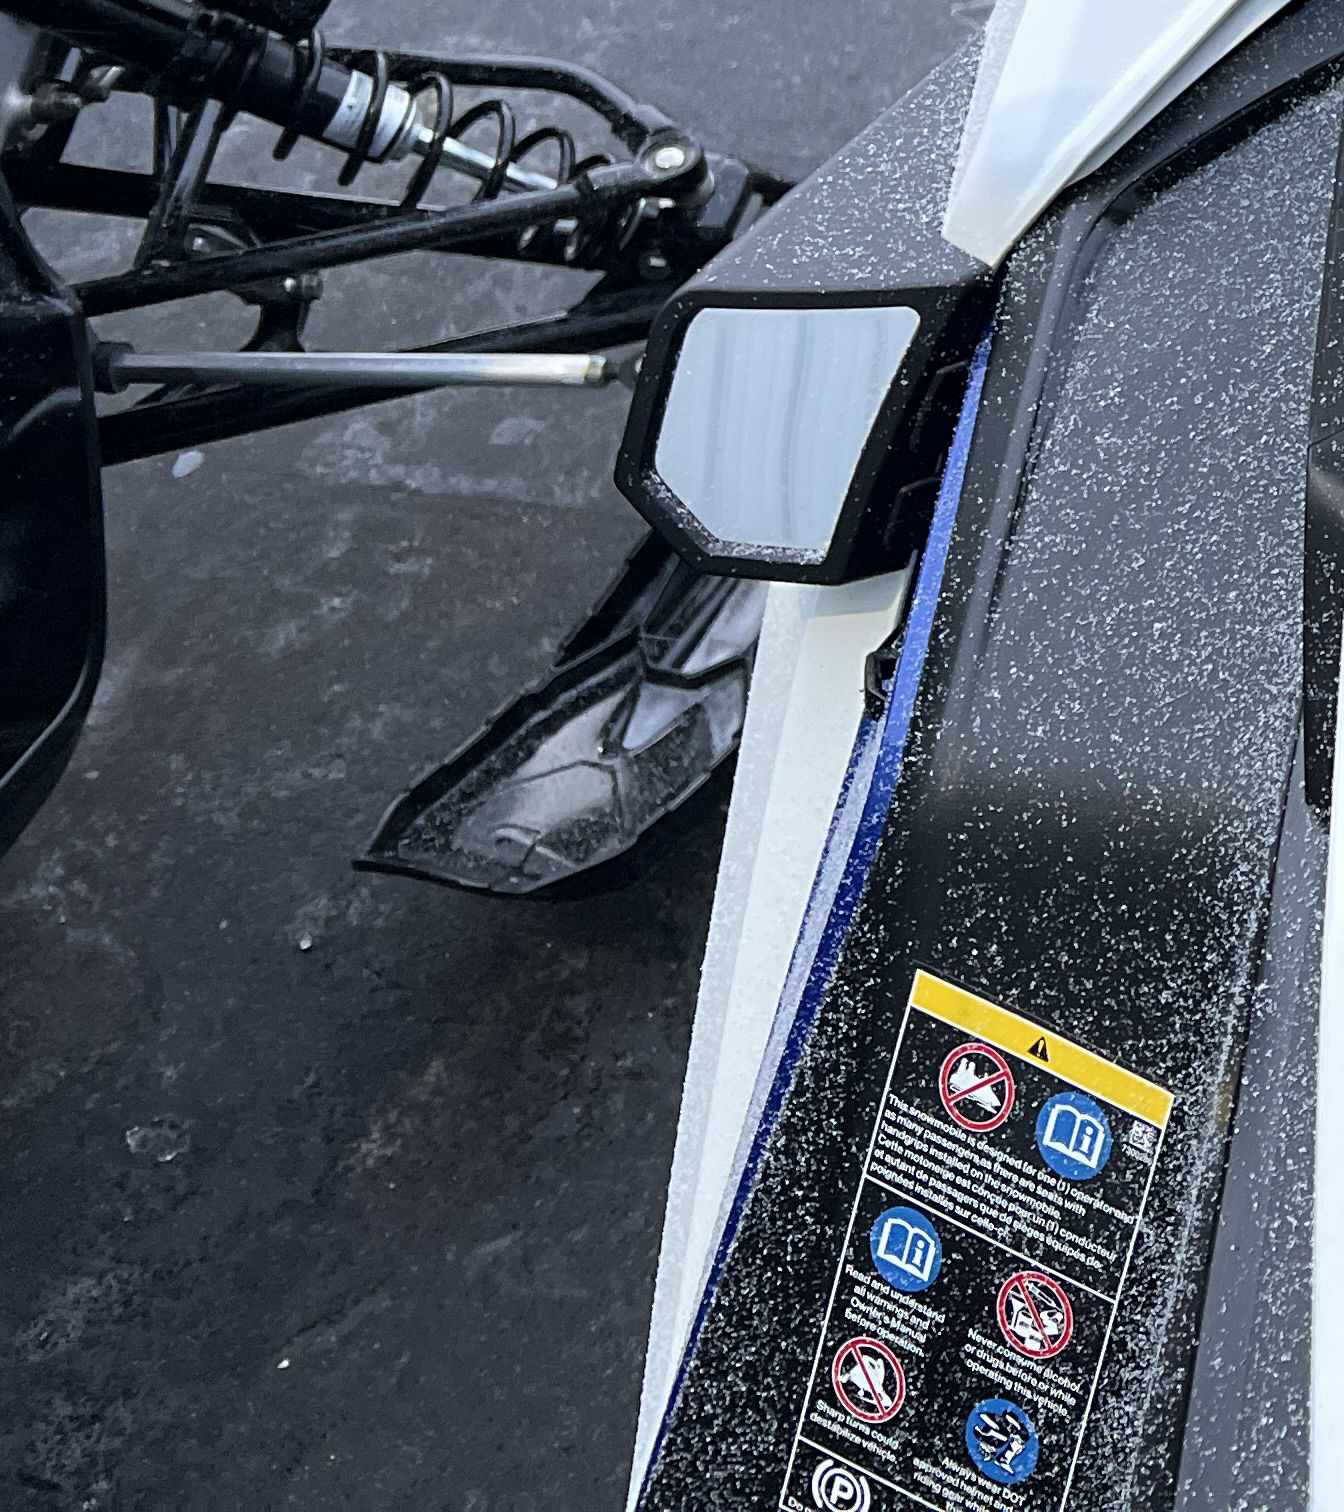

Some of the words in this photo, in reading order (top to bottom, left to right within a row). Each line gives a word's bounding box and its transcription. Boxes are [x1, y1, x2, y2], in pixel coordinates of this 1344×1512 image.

[880, 1120, 929, 1152] handgrips
[929, 1145, 970, 1174] installed
[970, 1168, 983, 1180] on
[984, 1173, 1000, 1189] the
[1000, 1183, 1062, 1220] snowmobile.
[884, 1109, 896, 1121] as
[896, 1115, 924, 1136] many
[923, 1129, 980, 1165] passengers
[978, 1158, 992, 1170] as
[993, 1161, 1019, 1183] there
[1018, 1177, 1036, 1192] are
[1036, 1184, 1064, 1206] seats
[1064, 1199, 1086, 1216] with
[888, 1093, 909, 1112] This
[908, 1106, 967, 1142] snowmobile
[967, 1135, 976, 1147] is
[976, 1140, 1023, 1170] designed
[1022, 1161, 1037, 1176] for
[1037, 1170, 1056, 1186] one
[1056, 1178, 1070, 1195] (1)
[1070, 1188, 1115, 1215] operator
[1114, 1208, 1135, 1225] and
[870, 1161, 915, 1190] poignées
[954, 1205, 971, 1219] sur
[874, 1149, 884, 1160] et
[884, 1154, 916, 1176] autant
[916, 1170, 929, 1182] de
[928, 1177, 979, 1209] passagers
[979, 1202, 999, 1218] que
[998, 1212, 1013, 1225] de
[878, 1133, 904, 1155] Cette
[904, 1149, 955, 1181] motoneige
[955, 1176, 972, 1190] est
[1007, 1202, 1032, 1222] pour
[1030, 1213, 1046, 1227] un
[1045, 1219, 1059, 1235] (1)
[1059, 1228, 1118, 1263] conducteur
[844, 1307, 876, 1332] before
[845, 1264, 871, 1285] Read
[870, 1280, 890, 1295] and
[890, 1290, 946, 1324] understand
[854, 1285, 866, 1297] all
[866, 1291, 910, 1320] warnings
[909, 1315, 930, 1330] and
[890, 1316, 927, 1344] Manual
[967, 1328, 996, 1350] Never
[996, 1345, 1043, 1374] consume
[964, 1343, 976, 1354] or
[976, 1349, 1005, 1370] drugs
[1004, 1362, 1038, 1387] before
[1038, 1381, 1050, 1392] or
[1050, 1384, 1076, 1406] while
[965, 1358, 1013, 1391] operating
[1013, 1381, 1032, 1399] this
[810, 1412, 861, 1444] destabilize
[816, 1399, 845, 1422] Sharp
[846, 1415, 870, 1435] turns
[871, 1430, 900, 1450] could
[788, 1496, 804, 1511] Do
[913, 1457, 960, 1487] approved
[960, 1480, 994, 1506] helmet
[993, 1500, 1014, 1512] and
[913, 1471, 942, 1494] riding
[942, 1487, 964, 1504] gear
[941, 1456, 977, 1482] Always
[977, 1476, 1002, 1494] wear
[1002, 1487, 1026, 1506] DOT
